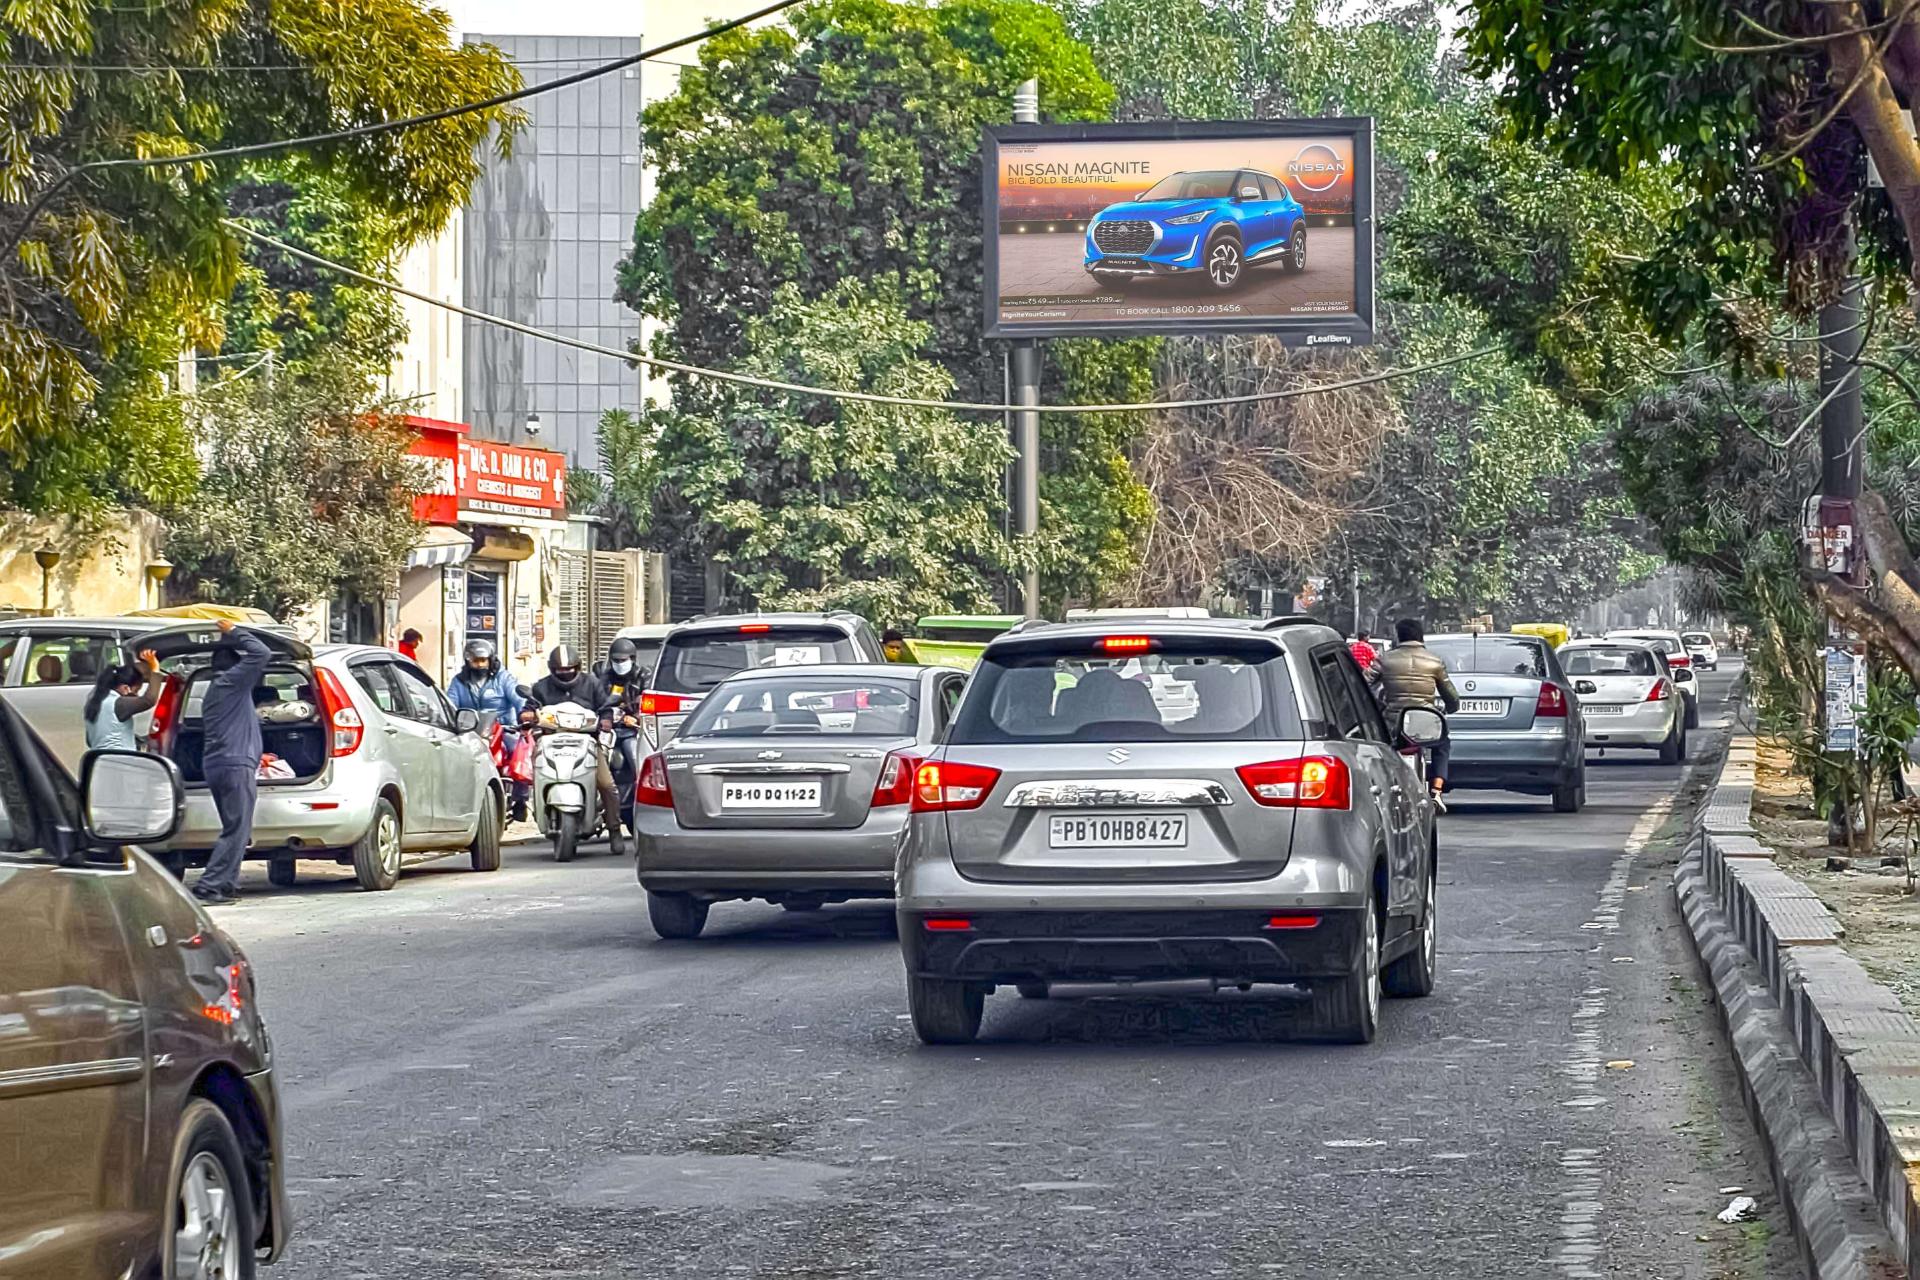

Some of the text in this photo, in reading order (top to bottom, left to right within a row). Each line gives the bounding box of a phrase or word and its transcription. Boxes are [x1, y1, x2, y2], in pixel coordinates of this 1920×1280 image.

[1008, 161, 1150, 176] NISSAN MAGNITE
[1288, 163, 1346, 172] NISSAN
[1008, 175, 1119, 185] BIG. BOLD. BEAUTIFUL.
[1197, 305, 1215, 313] 209
[1218, 304, 1240, 312] 3456
[502, 453, 522, 478] RAM
[524, 456, 532, 480] &
[533, 457, 549, 482] CO.
[1807, 529, 1847, 539] DANGER
[726, 789, 761, 800] PB-10
[765, 789, 781, 800] DQ
[1063, 820, 1183, 841] PB10HB8427
